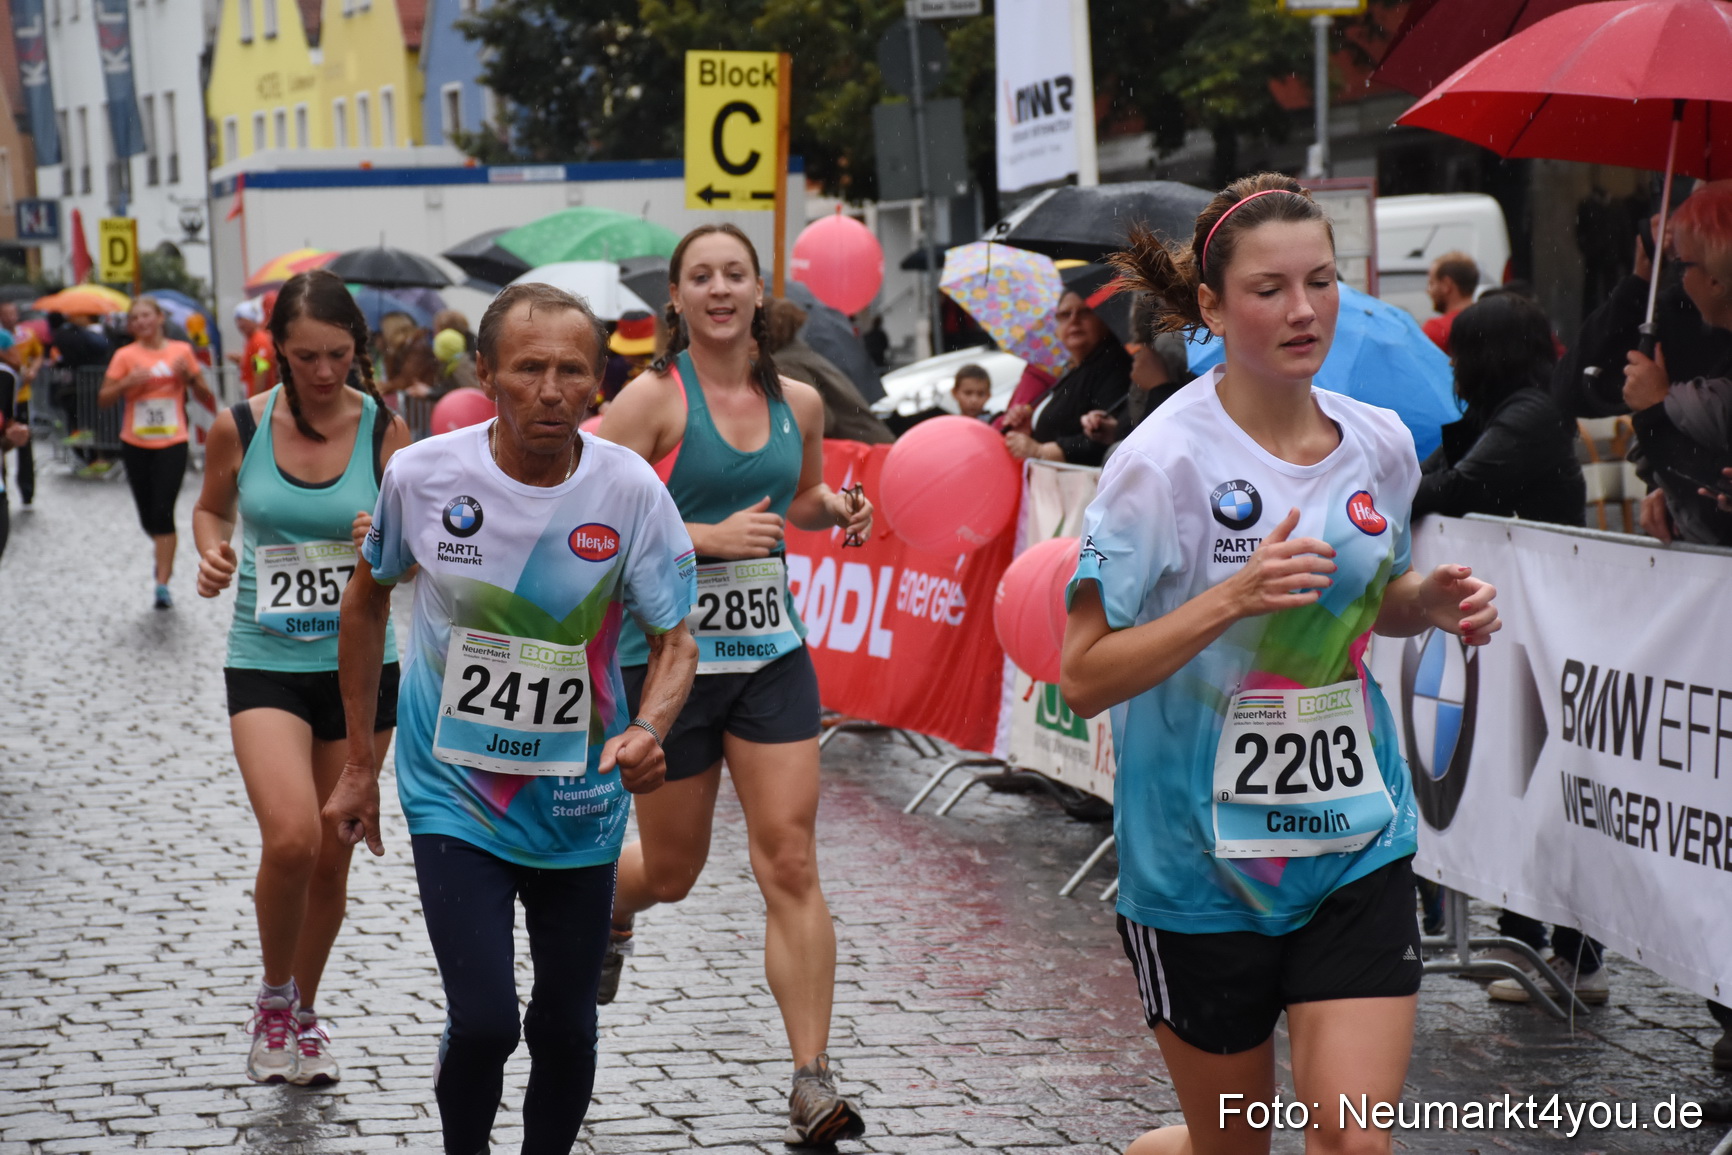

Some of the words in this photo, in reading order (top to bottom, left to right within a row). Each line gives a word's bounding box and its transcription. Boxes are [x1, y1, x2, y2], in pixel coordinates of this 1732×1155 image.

[699, 58, 777, 87] Block
[711, 100, 762, 177] C
[107, 236, 129, 268] D
[1212, 481, 1256, 501] BMW
[446, 496, 480, 512] BMW
[437, 541, 483, 557] PARTL
[577, 532, 616, 553] Hervis
[437, 552, 483, 566] Neumarkt
[736, 562, 778, 578] BOCK
[271, 565, 355, 608] 2857
[697, 586, 780, 631] 2856
[462, 643, 511, 660] NeuerMarkt
[520, 643, 586, 666] BOCK
[714, 640, 779, 657] Rebecca
[456, 664, 585, 725] 2412
[1298, 688, 1352, 716] BOCK
[445, 706, 452, 716] A
[1233, 710, 1287, 720] NeuerMarkt
[1561, 658, 1653, 761] BMW
[486, 733, 541, 757] Josef
[1235, 725, 1364, 795] 2203
[553, 781, 616, 801] Neumarkter
[1221, 791, 1230, 801] D
[552, 798, 609, 817] Stadtlauf
[1561, 770, 1661, 852] WENIGER
[1266, 809, 1351, 834] Carolin
